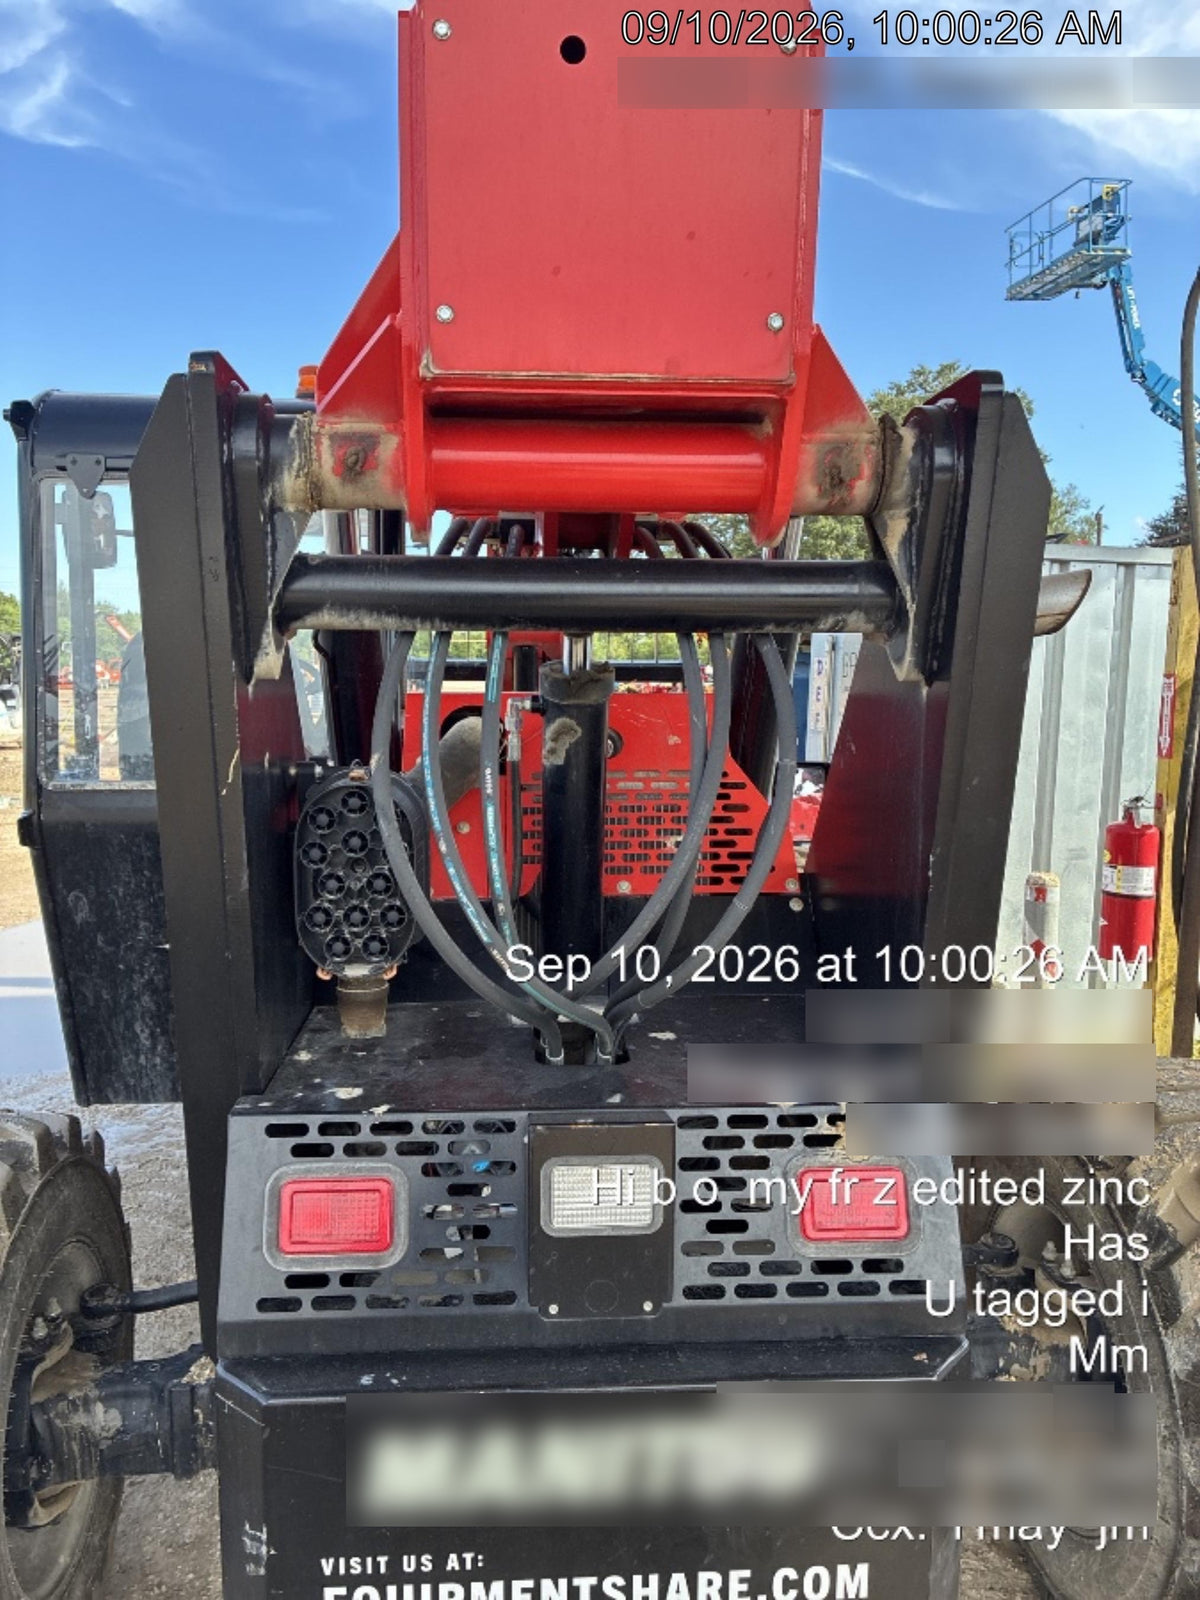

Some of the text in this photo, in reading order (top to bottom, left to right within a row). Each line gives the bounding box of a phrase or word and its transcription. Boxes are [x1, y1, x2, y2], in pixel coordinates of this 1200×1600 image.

[320, 1552, 484, 1576] VISIT US AT:
